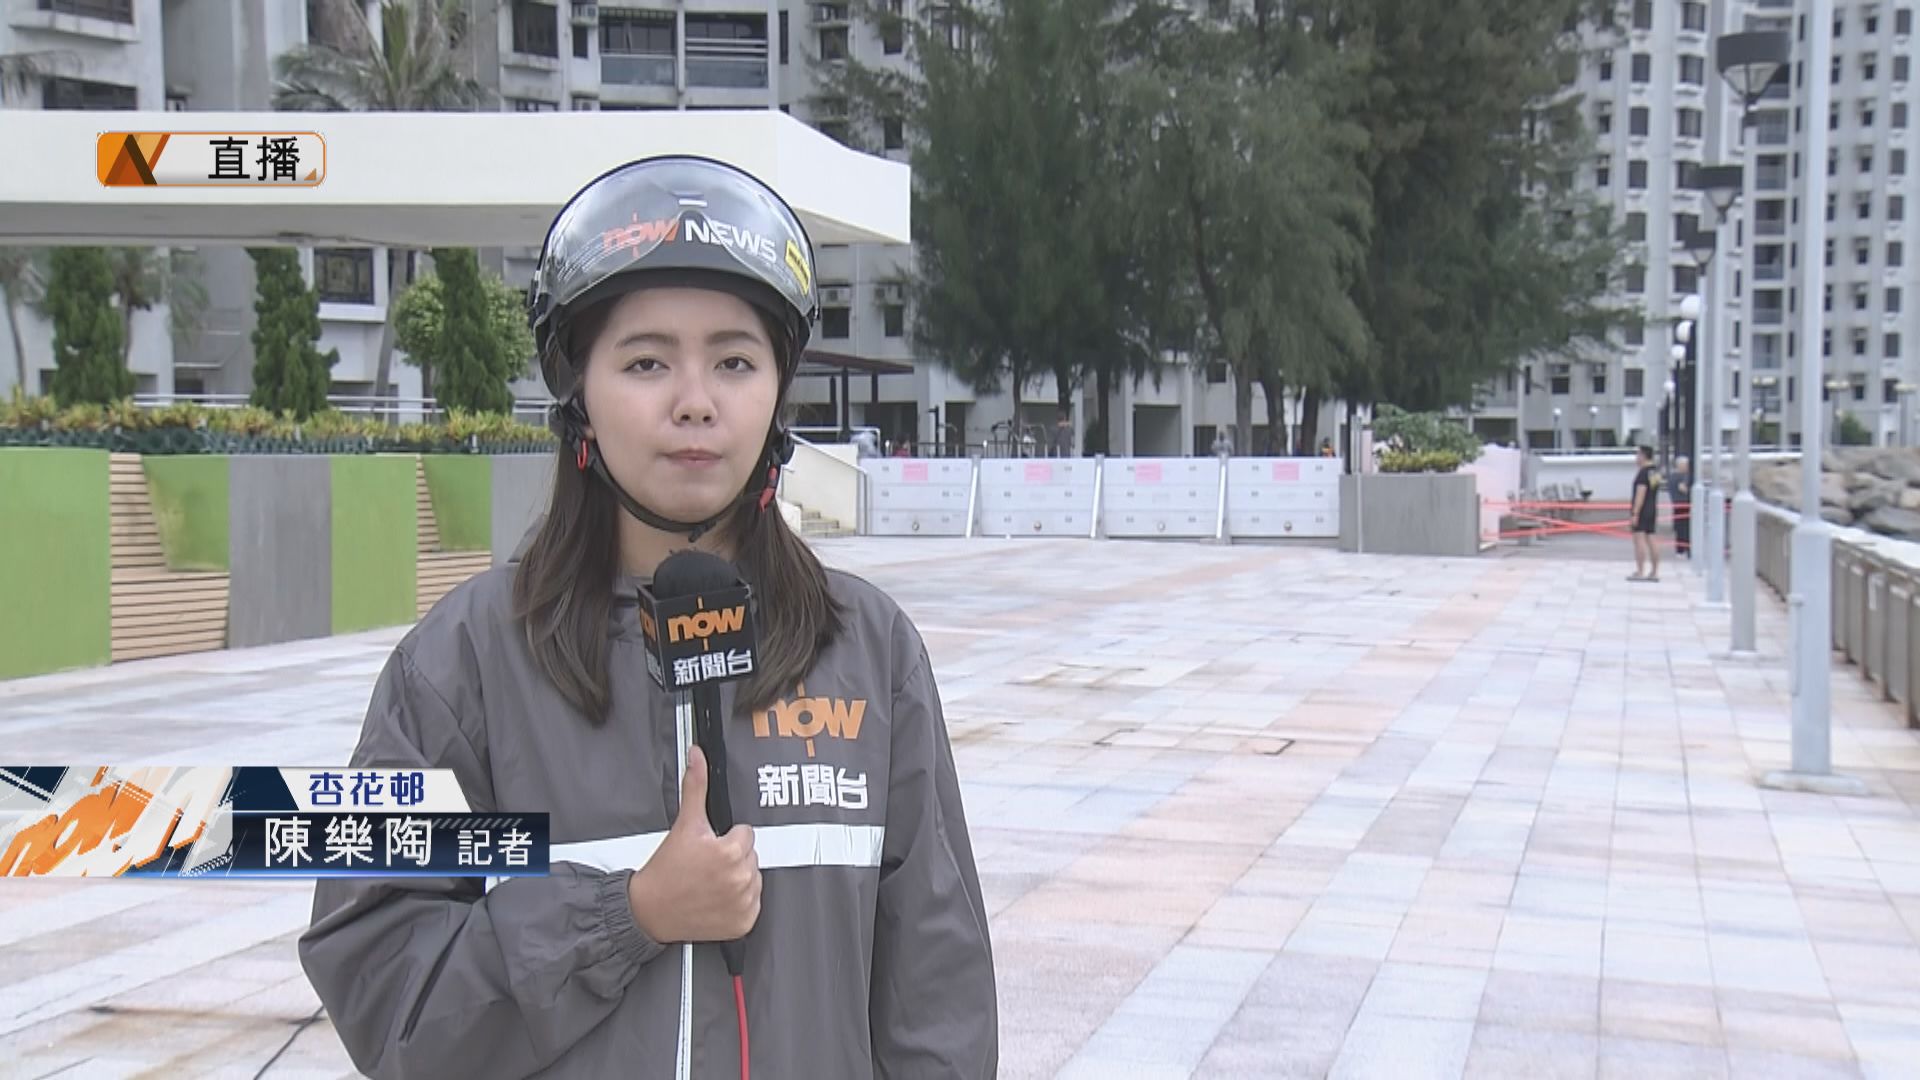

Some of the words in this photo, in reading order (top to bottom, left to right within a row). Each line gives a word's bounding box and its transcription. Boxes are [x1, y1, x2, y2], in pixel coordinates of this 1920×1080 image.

[603, 219, 681, 256] now
[685, 219, 777, 264] NEWS
[667, 606, 745, 642] now
[672, 649, 753, 686] 新聞台
[752, 697, 867, 740] now
[757, 763, 868, 809] 新聞台
